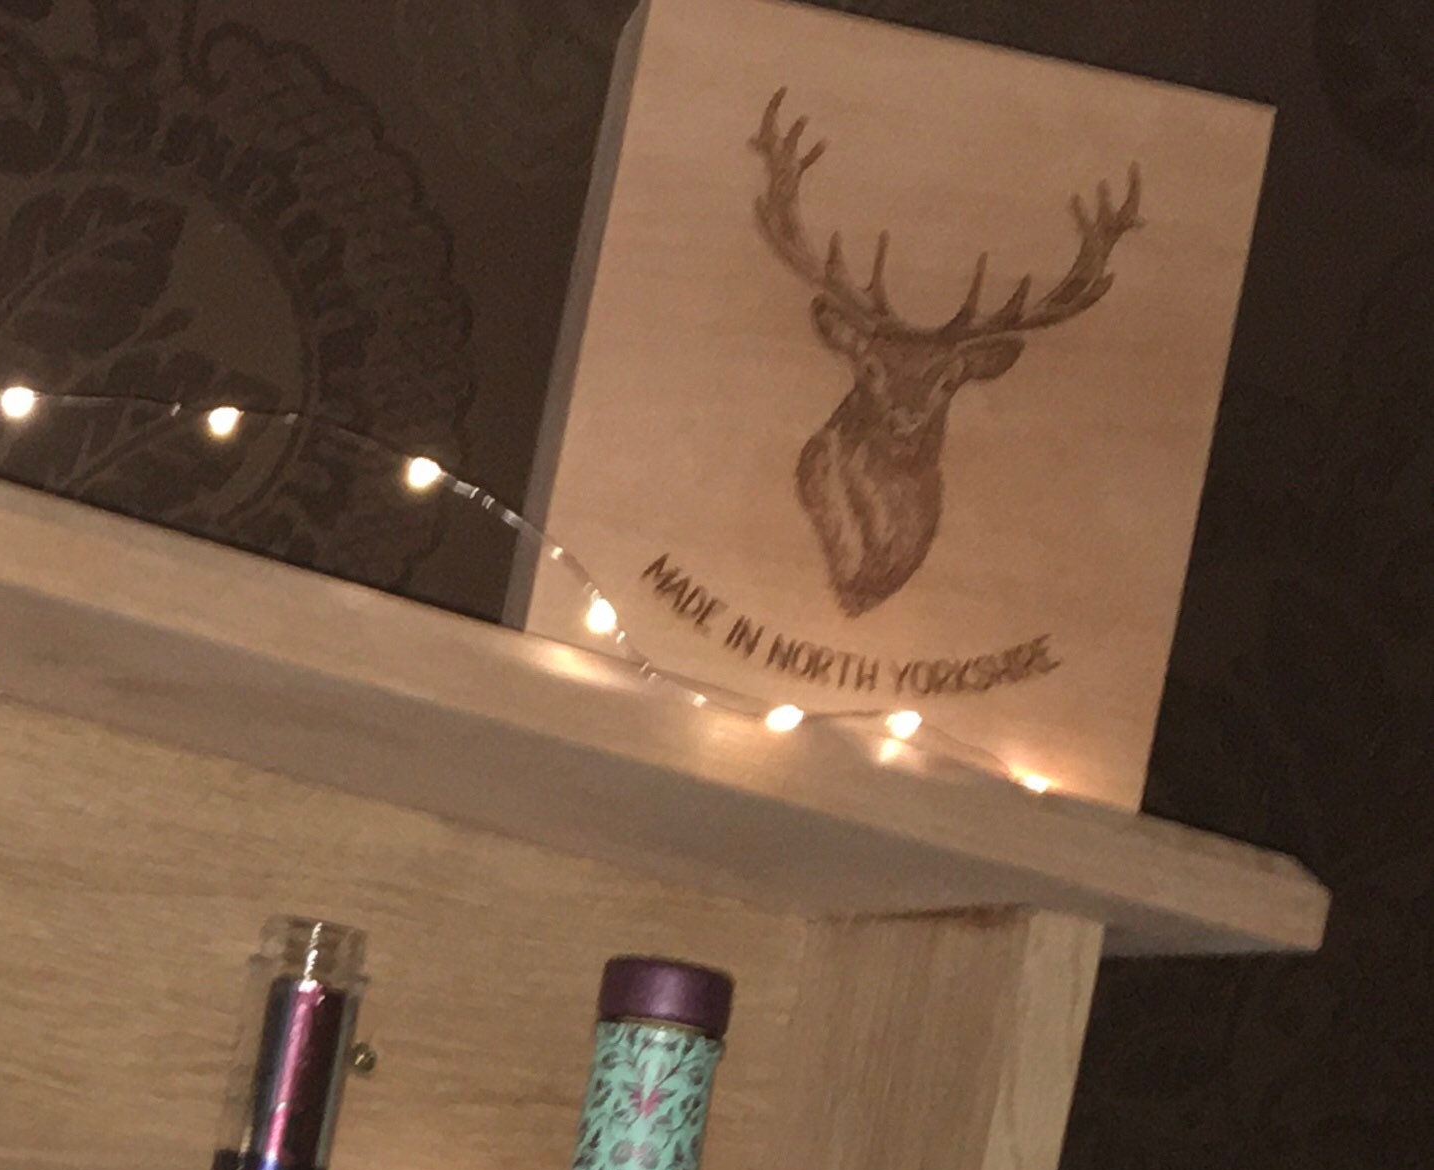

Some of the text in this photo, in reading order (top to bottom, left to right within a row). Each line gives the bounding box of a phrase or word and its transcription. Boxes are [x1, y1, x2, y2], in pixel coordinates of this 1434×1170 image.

[640, 552, 1063, 697] MADE IN NORTH YORKSHIRE
